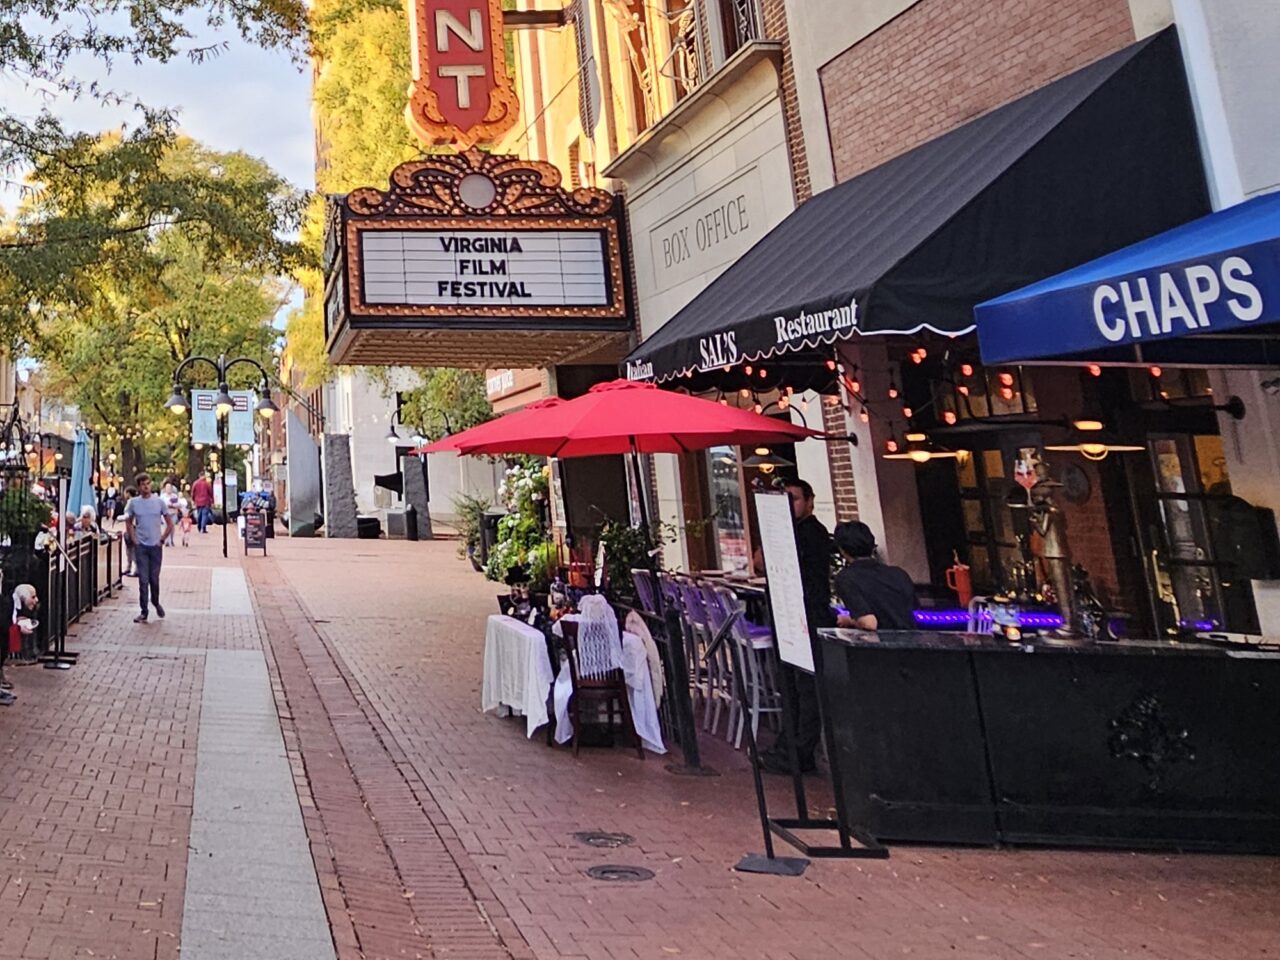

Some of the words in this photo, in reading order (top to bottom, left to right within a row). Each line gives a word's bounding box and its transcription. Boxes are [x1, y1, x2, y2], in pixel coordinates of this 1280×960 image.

[439, 236, 523, 253] VIRGINIA
[662, 226, 691, 269] BOX
[695, 194, 750, 251] OFFICE
[437, 280, 532, 298] FESTIVAL
[459, 259, 506, 275] FILM
[1093, 256, 1263, 341] CHAPS
[700, 331, 738, 368] SAL'S
[774, 298, 858, 344] Restaurant
